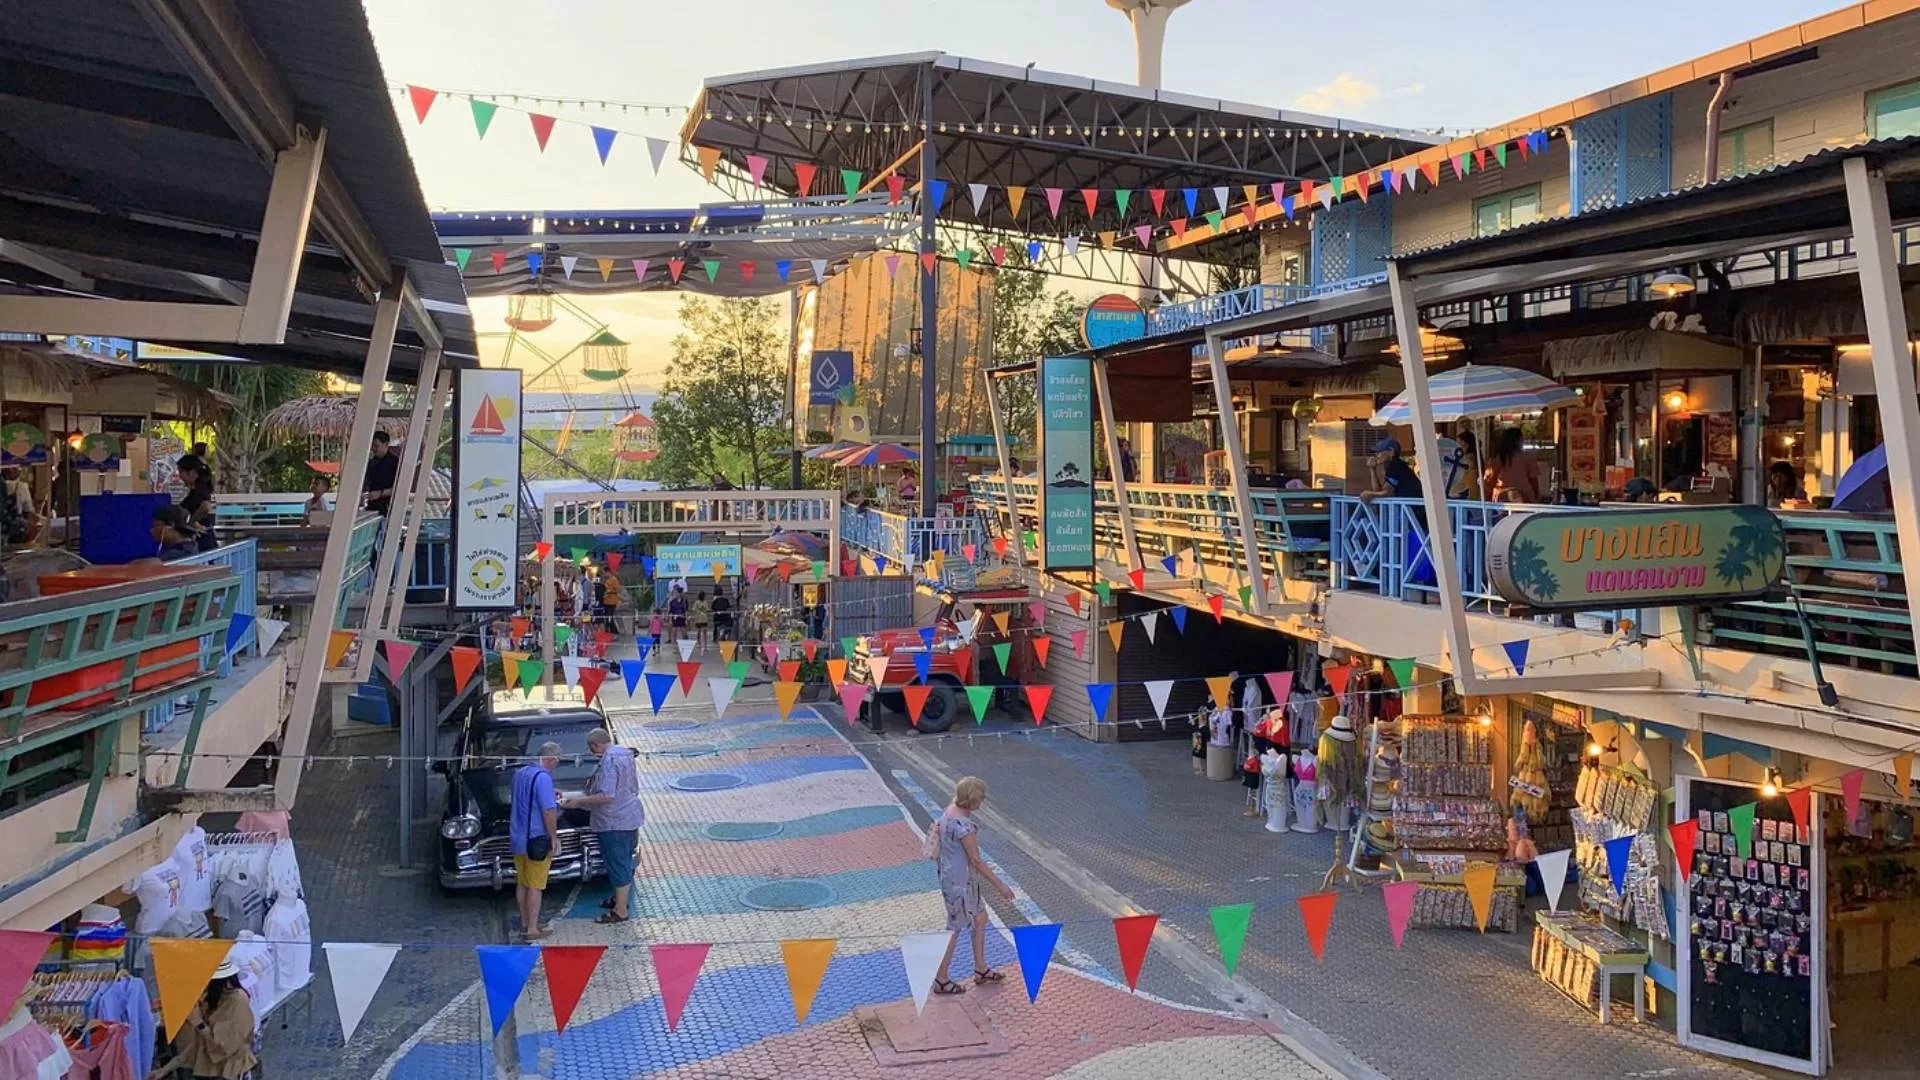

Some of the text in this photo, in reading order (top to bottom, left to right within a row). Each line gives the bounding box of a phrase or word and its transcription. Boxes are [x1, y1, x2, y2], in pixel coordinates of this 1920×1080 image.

[1560, 520, 1704, 563] บางแสน
[1586, 566, 1706, 593] แดนคนงาม
